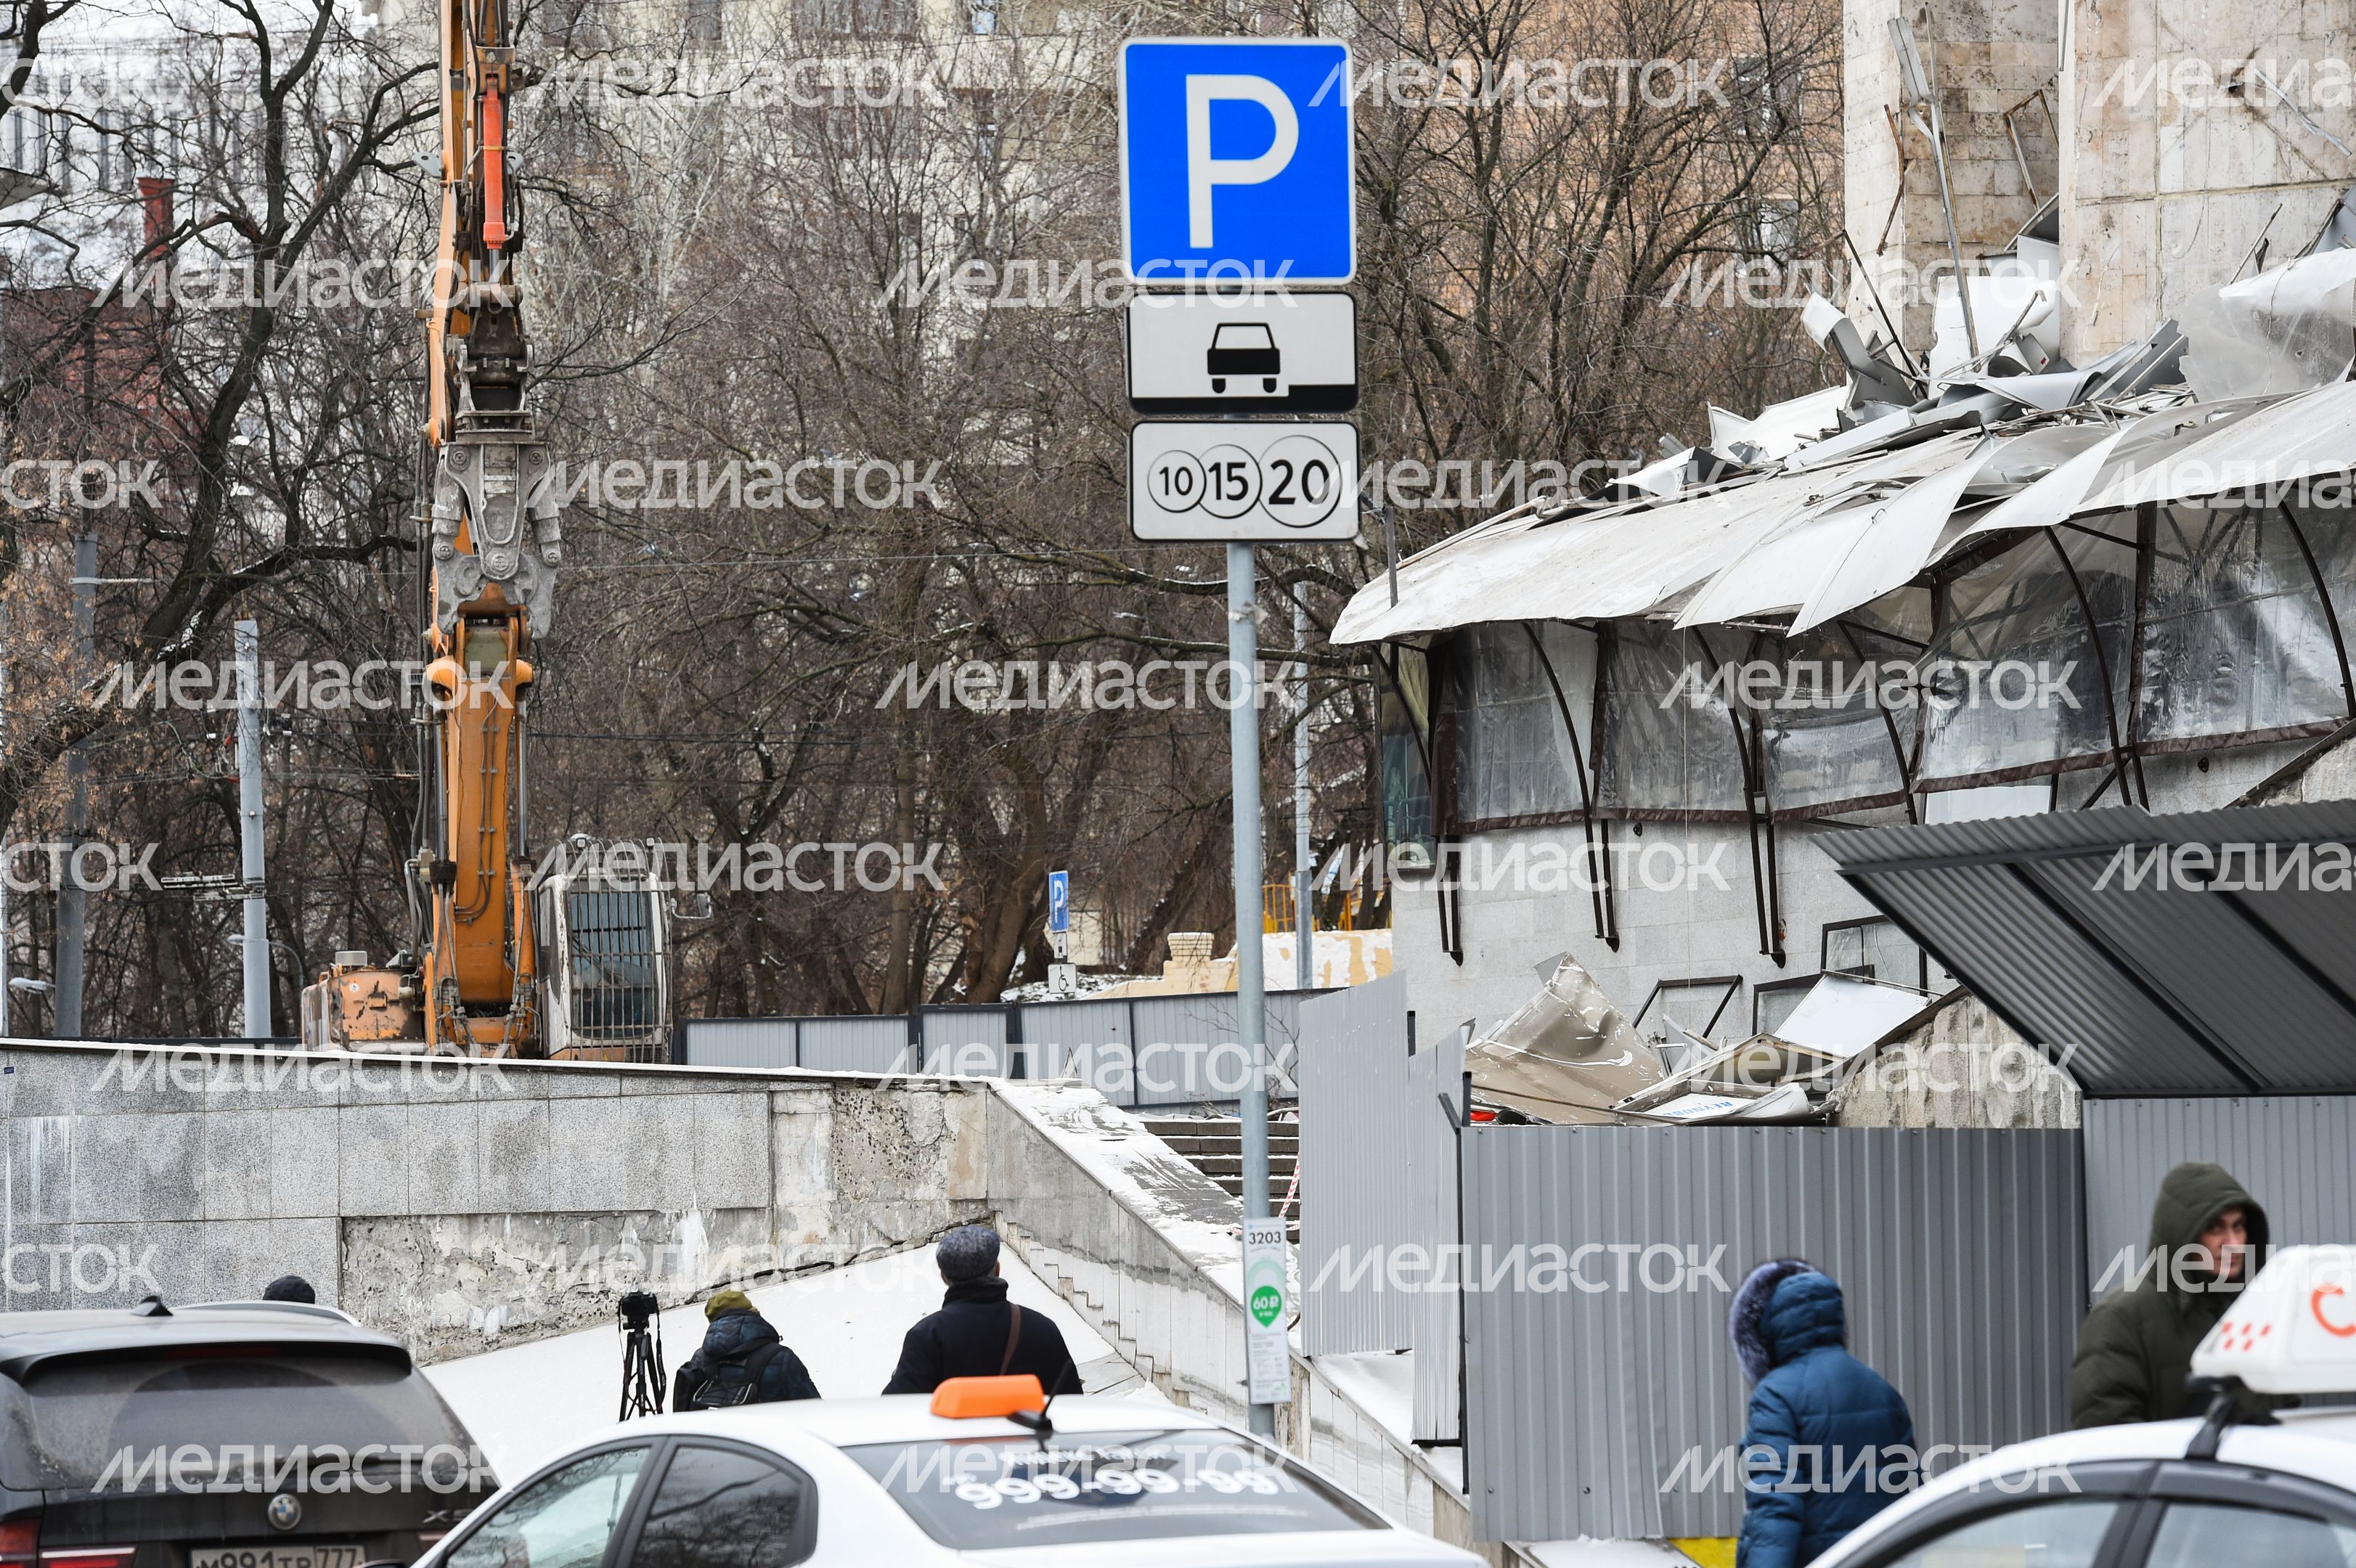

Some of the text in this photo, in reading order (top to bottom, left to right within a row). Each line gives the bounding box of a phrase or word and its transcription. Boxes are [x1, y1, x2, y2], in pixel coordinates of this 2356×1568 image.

[1186, 74, 1300, 249] P
[1159, 459, 1330, 505] 10 15 20
[1053, 879, 1064, 924] P
[1249, 1231, 1281, 1245] 3203
[317, 1548, 357, 1568] 777
